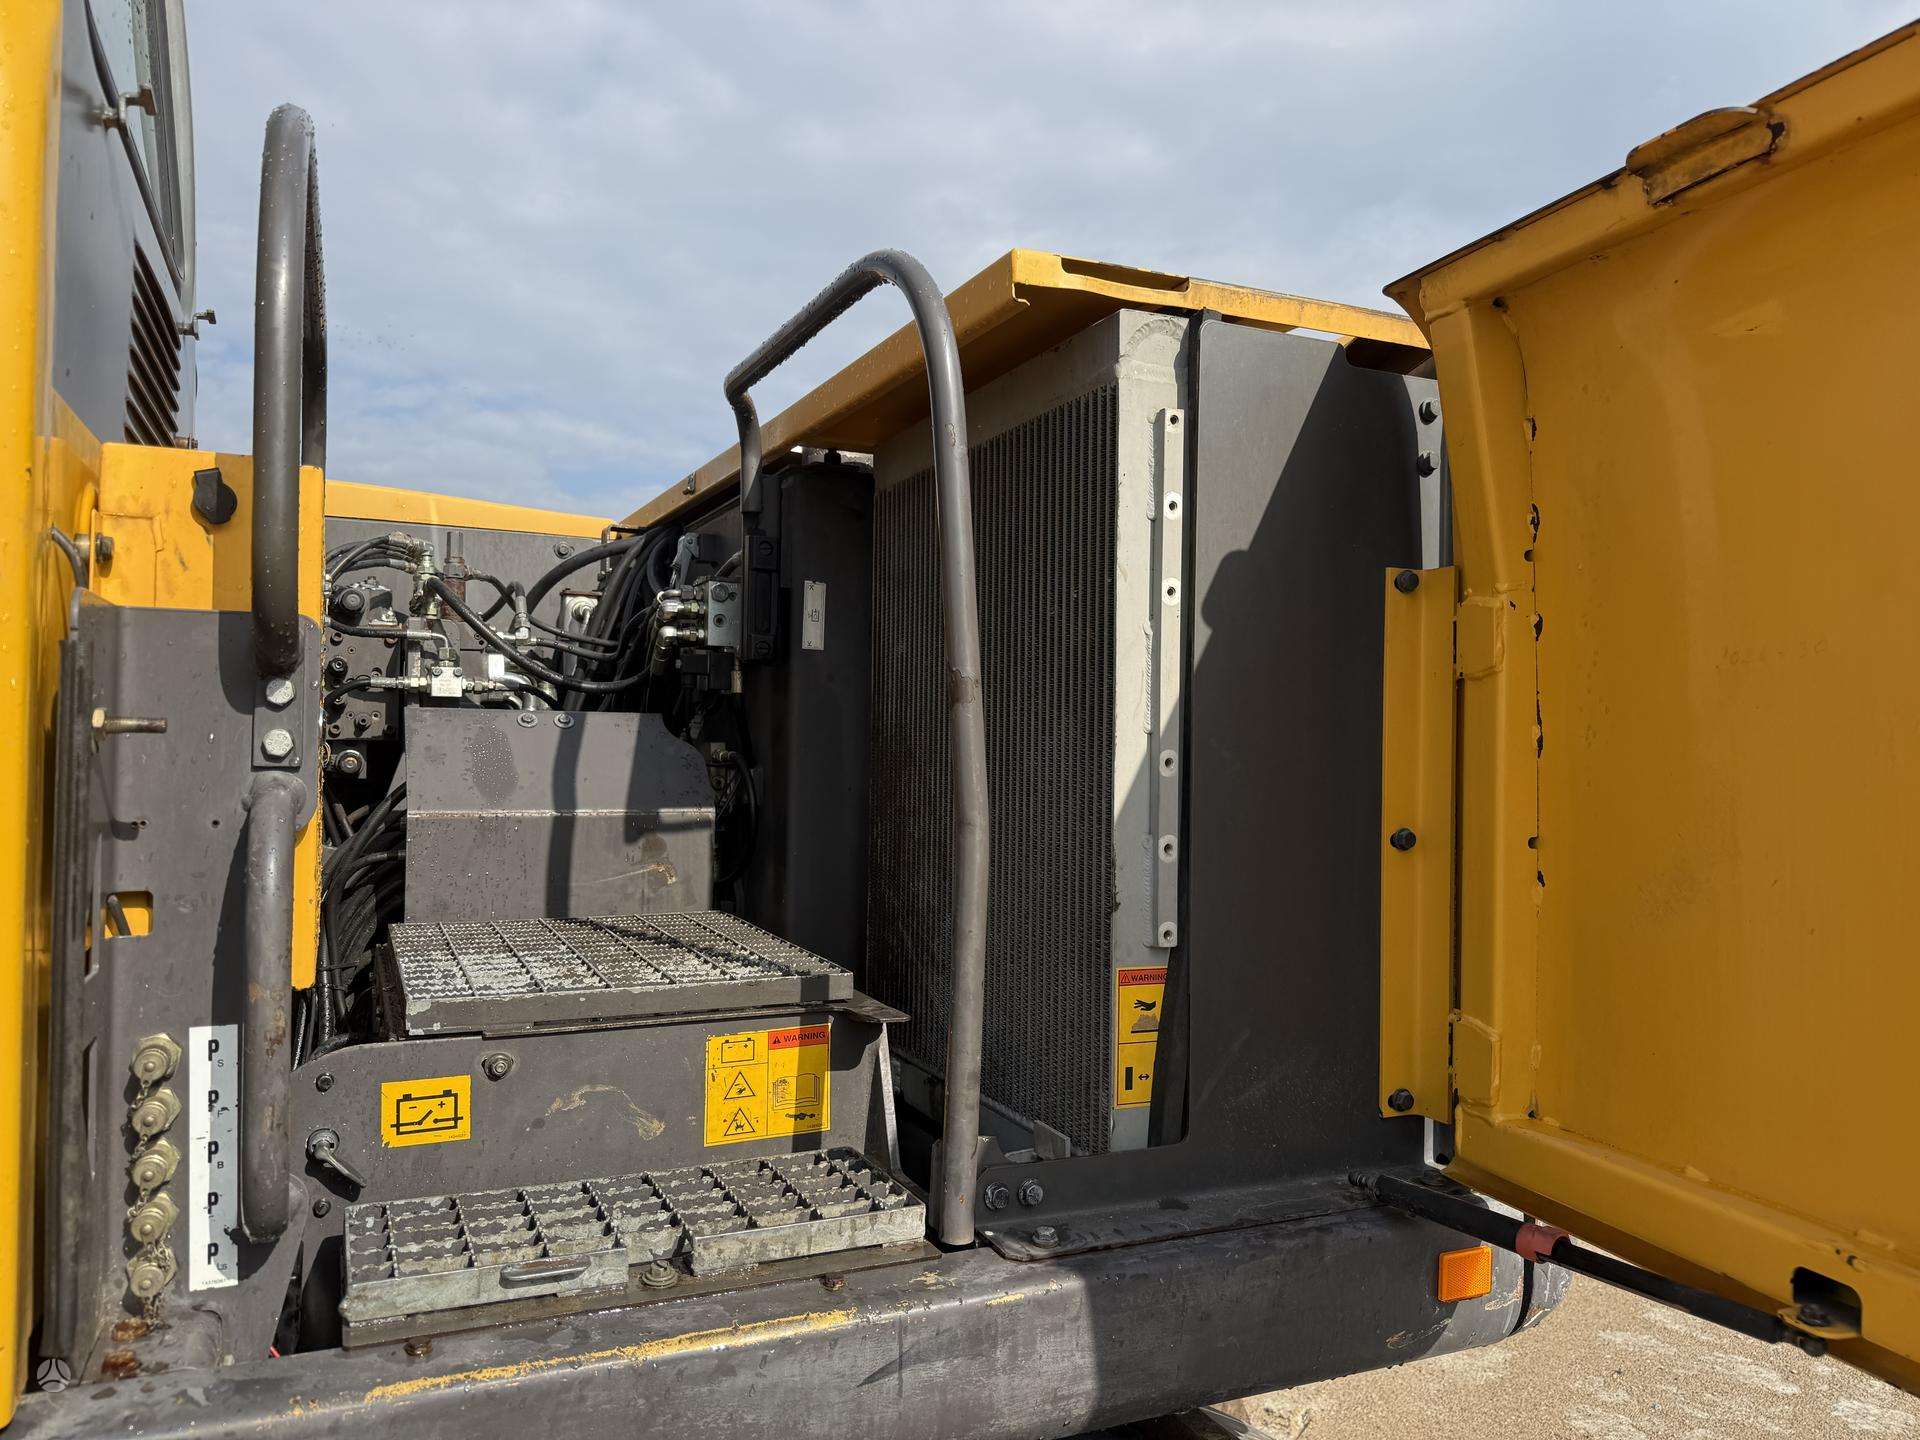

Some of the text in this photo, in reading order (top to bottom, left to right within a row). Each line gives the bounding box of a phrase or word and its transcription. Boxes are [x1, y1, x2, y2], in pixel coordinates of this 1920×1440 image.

[783, 1031, 825, 1042] WARNING
[208, 1039, 219, 1062] P
[208, 1140, 219, 1163] P
[208, 1191, 219, 1214] P
[208, 1242, 219, 1265] P
